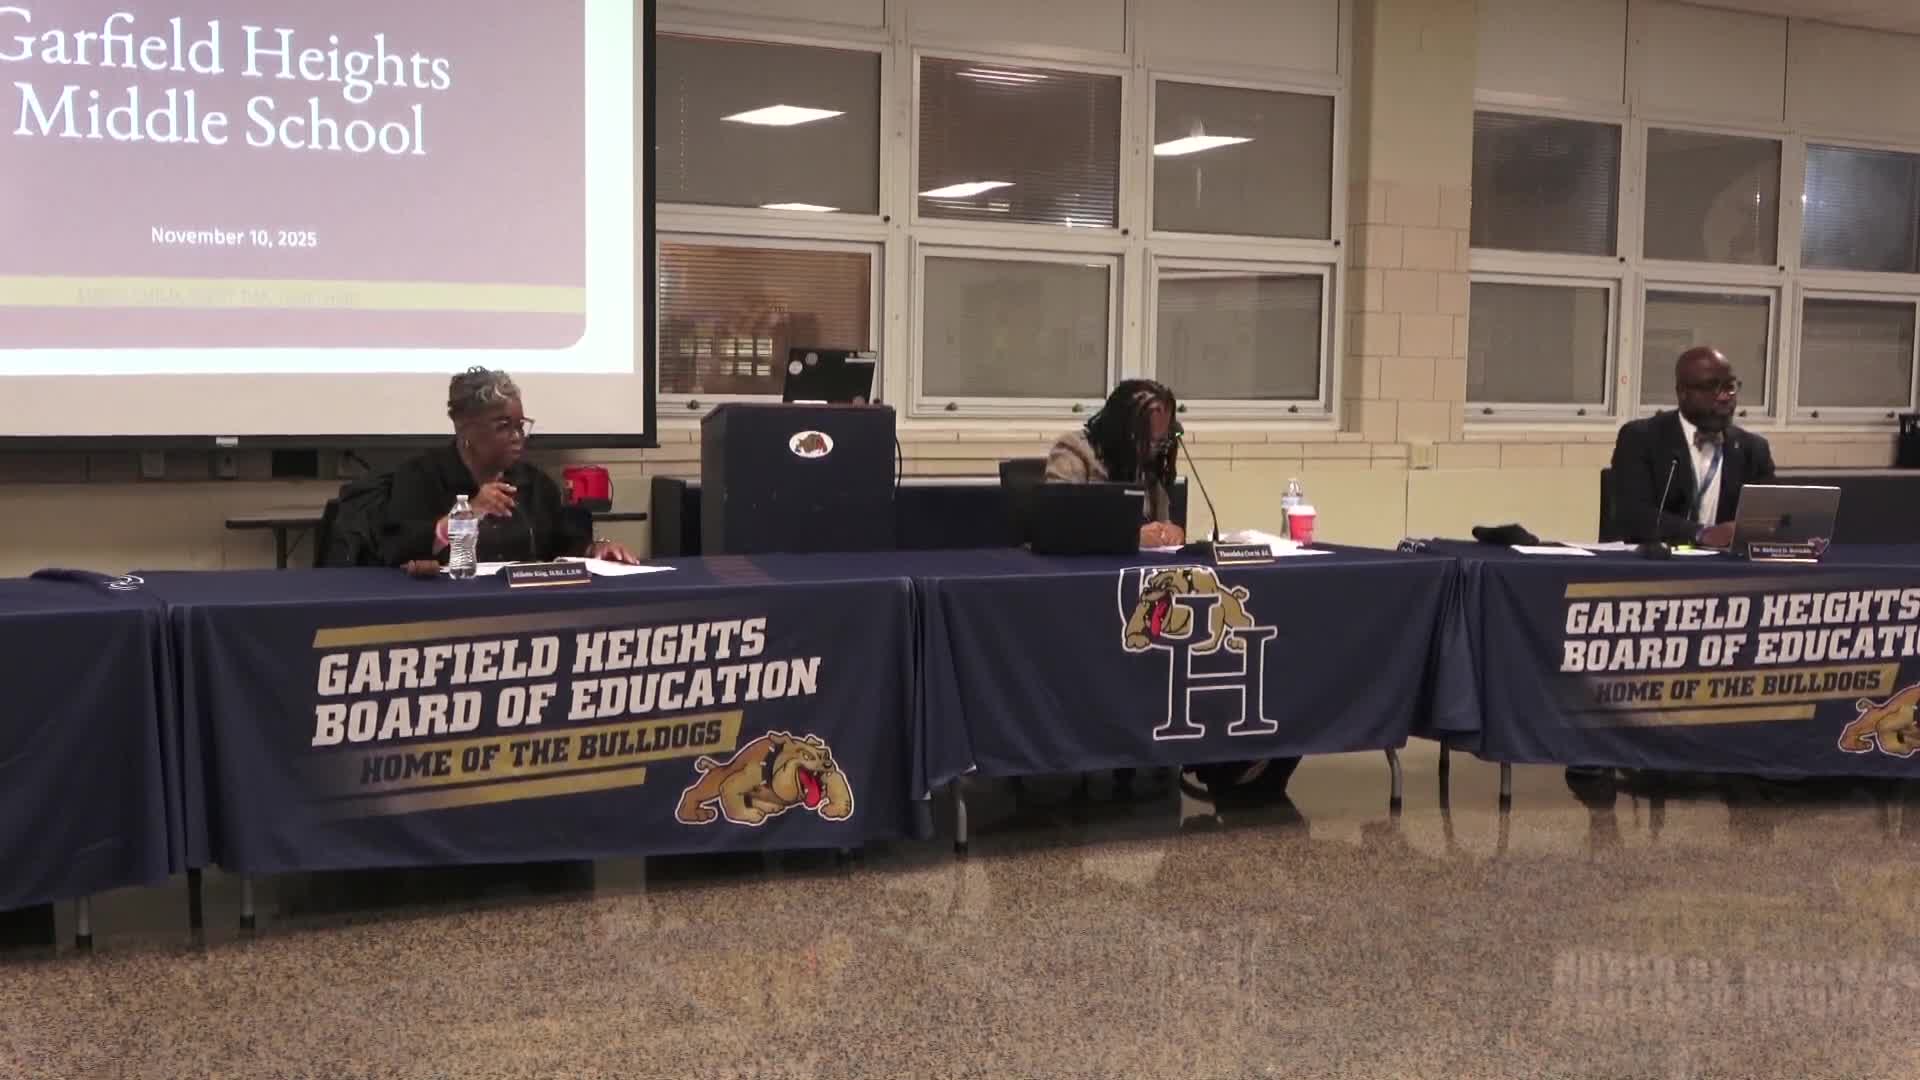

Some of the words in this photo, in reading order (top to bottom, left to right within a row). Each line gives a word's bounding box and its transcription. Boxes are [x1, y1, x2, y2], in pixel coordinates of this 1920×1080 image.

[0, 6, 225, 74] Garfield
[241, 26, 452, 103] Heights
[13, 82, 229, 145] Middle
[245, 96, 427, 155] School
[150, 226, 244, 247] November
[249, 229, 274, 249] 10,
[277, 230, 318, 248] 2025
[1565, 597, 1751, 634] GARFIELD
[1759, 588, 1920, 626] HEIGHTS
[317, 637, 560, 696] GARFIELD
[572, 617, 767, 673] HEIGHTS
[1560, 635, 1688, 672] BOARD
[1699, 633, 1747, 666] OF
[1755, 624, 1920, 664] EDUCATI
[312, 689, 482, 747] BOARD
[496, 682, 558, 727] OF
[568, 657, 821, 720] EDUCATION
[1597, 681, 1664, 705] HOME
[1670, 678, 1701, 700] OF
[1708, 676, 1756, 699] THE
[1762, 670, 1881, 697] BULLDOGS
[360, 751, 452, 785] HOME
[461, 744, 501, 771] OF
[510, 735, 569, 767] THE
[577, 719, 722, 761] BULLDOGS
